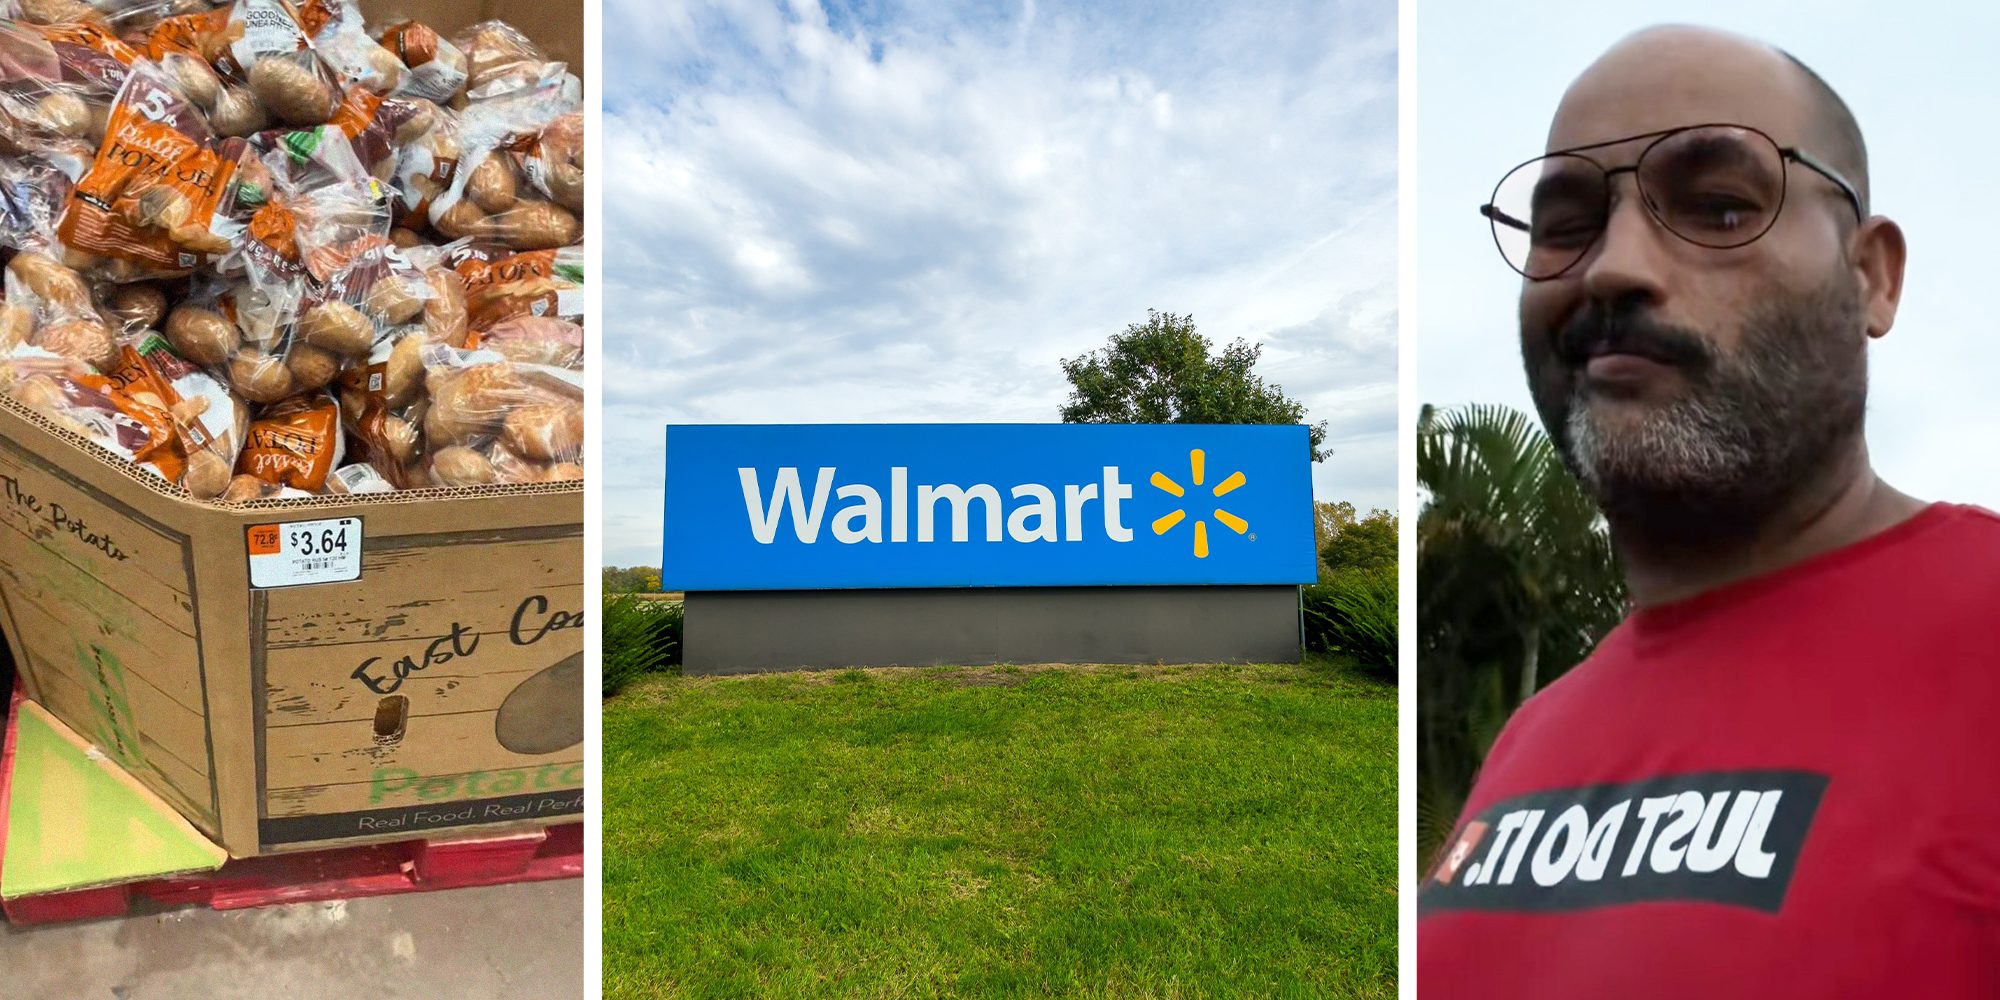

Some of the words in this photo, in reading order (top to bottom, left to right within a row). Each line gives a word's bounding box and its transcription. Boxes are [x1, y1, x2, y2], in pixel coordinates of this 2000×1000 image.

[107, 142, 214, 198] POTAOES
[0, 474, 42, 514] The
[738, 466, 1134, 544] Walmart
[49, 502, 129, 562] Potato
[290, 527, 347, 556] $3.64
[350, 622, 480, 694] East
[358, 813, 406, 830] Real
[414, 807, 476, 825] Food.
[484, 800, 531, 818] Real
[537, 794, 584, 812] Perf
